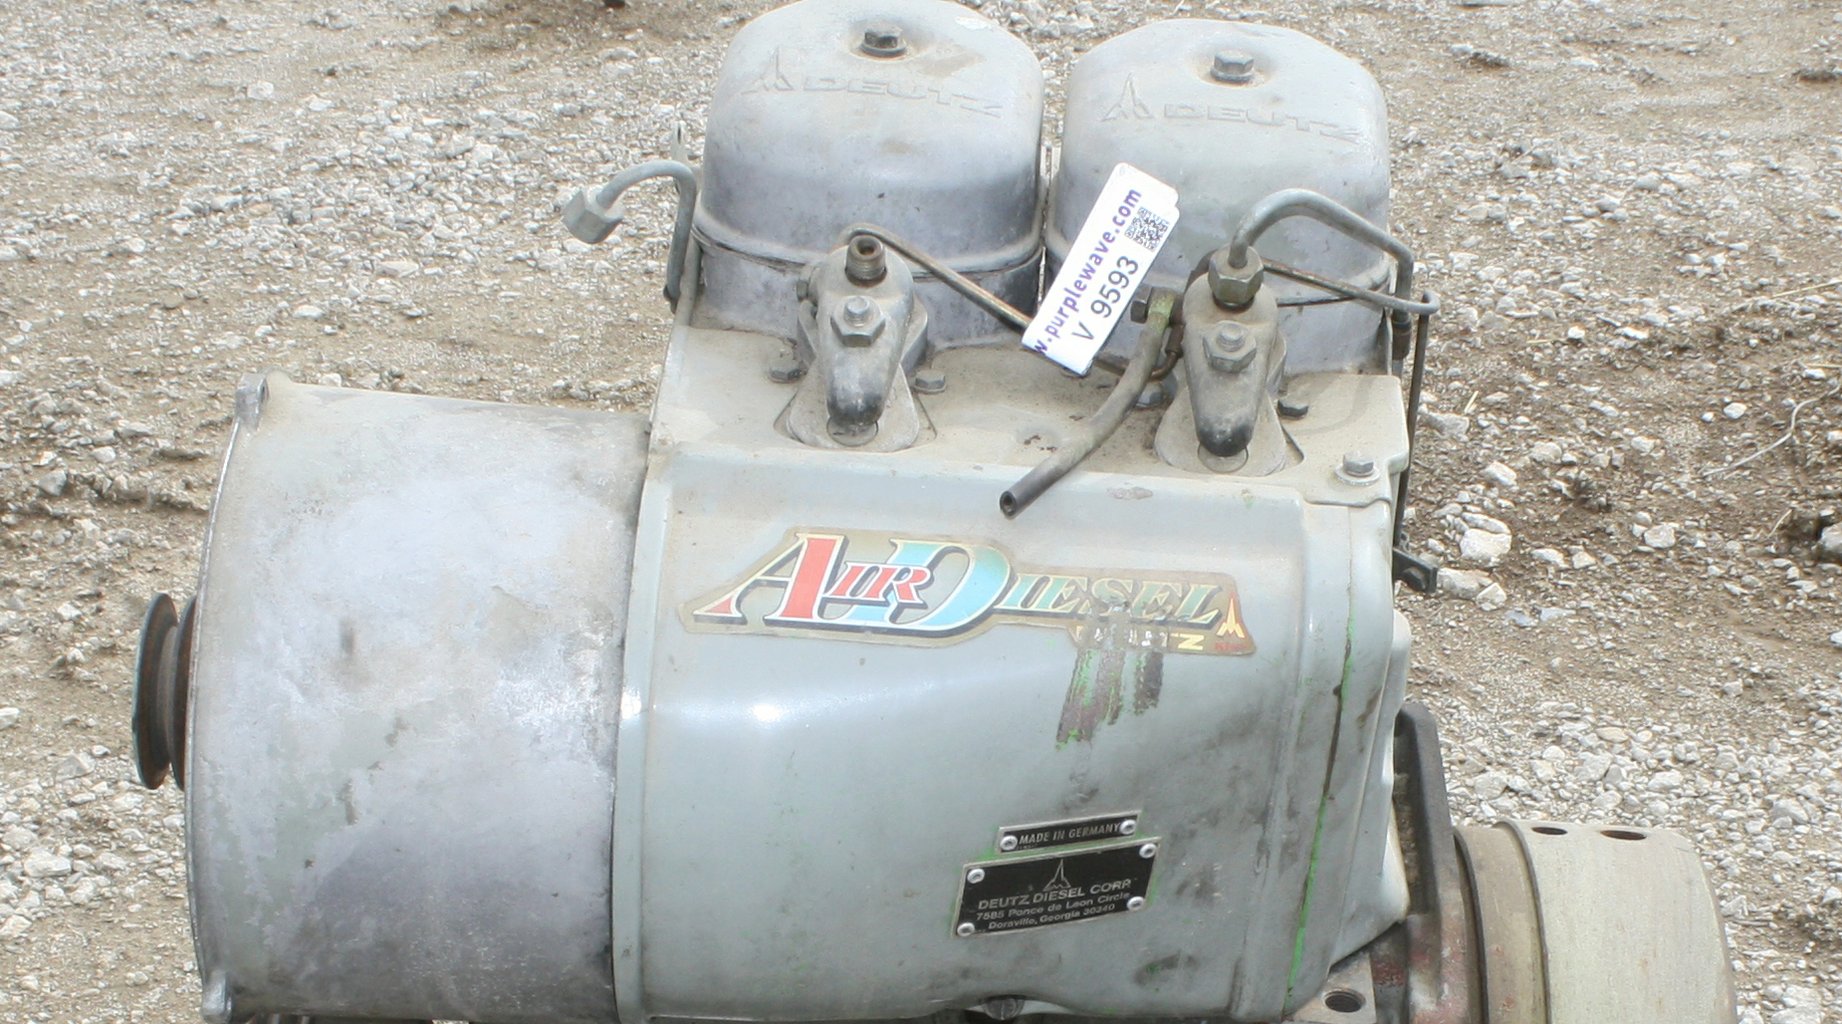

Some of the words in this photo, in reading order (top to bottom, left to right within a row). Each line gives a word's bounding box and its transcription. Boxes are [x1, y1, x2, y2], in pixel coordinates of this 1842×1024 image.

[803, 76, 1003, 118] DEUTZ
[1163, 104, 1361, 145] DEUTZ
[1072, 321, 1095, 340] V
[1090, 255, 1139, 318] 9593
[1019, 831, 1049, 845] MADE
[1052, 829, 1066, 841] IN
[1068, 822, 1121, 839] GERMANY
[978, 894, 1030, 910] DEUTZ
[1033, 888, 1085, 904] DIESEL
[1008, 906, 1043, 918] Ponce
[1047, 902, 1062, 912] de
[1065, 898, 1094, 910] Leon
[1097, 891, 1131, 904] Circle
[1039, 910, 1081, 926] Georgia
